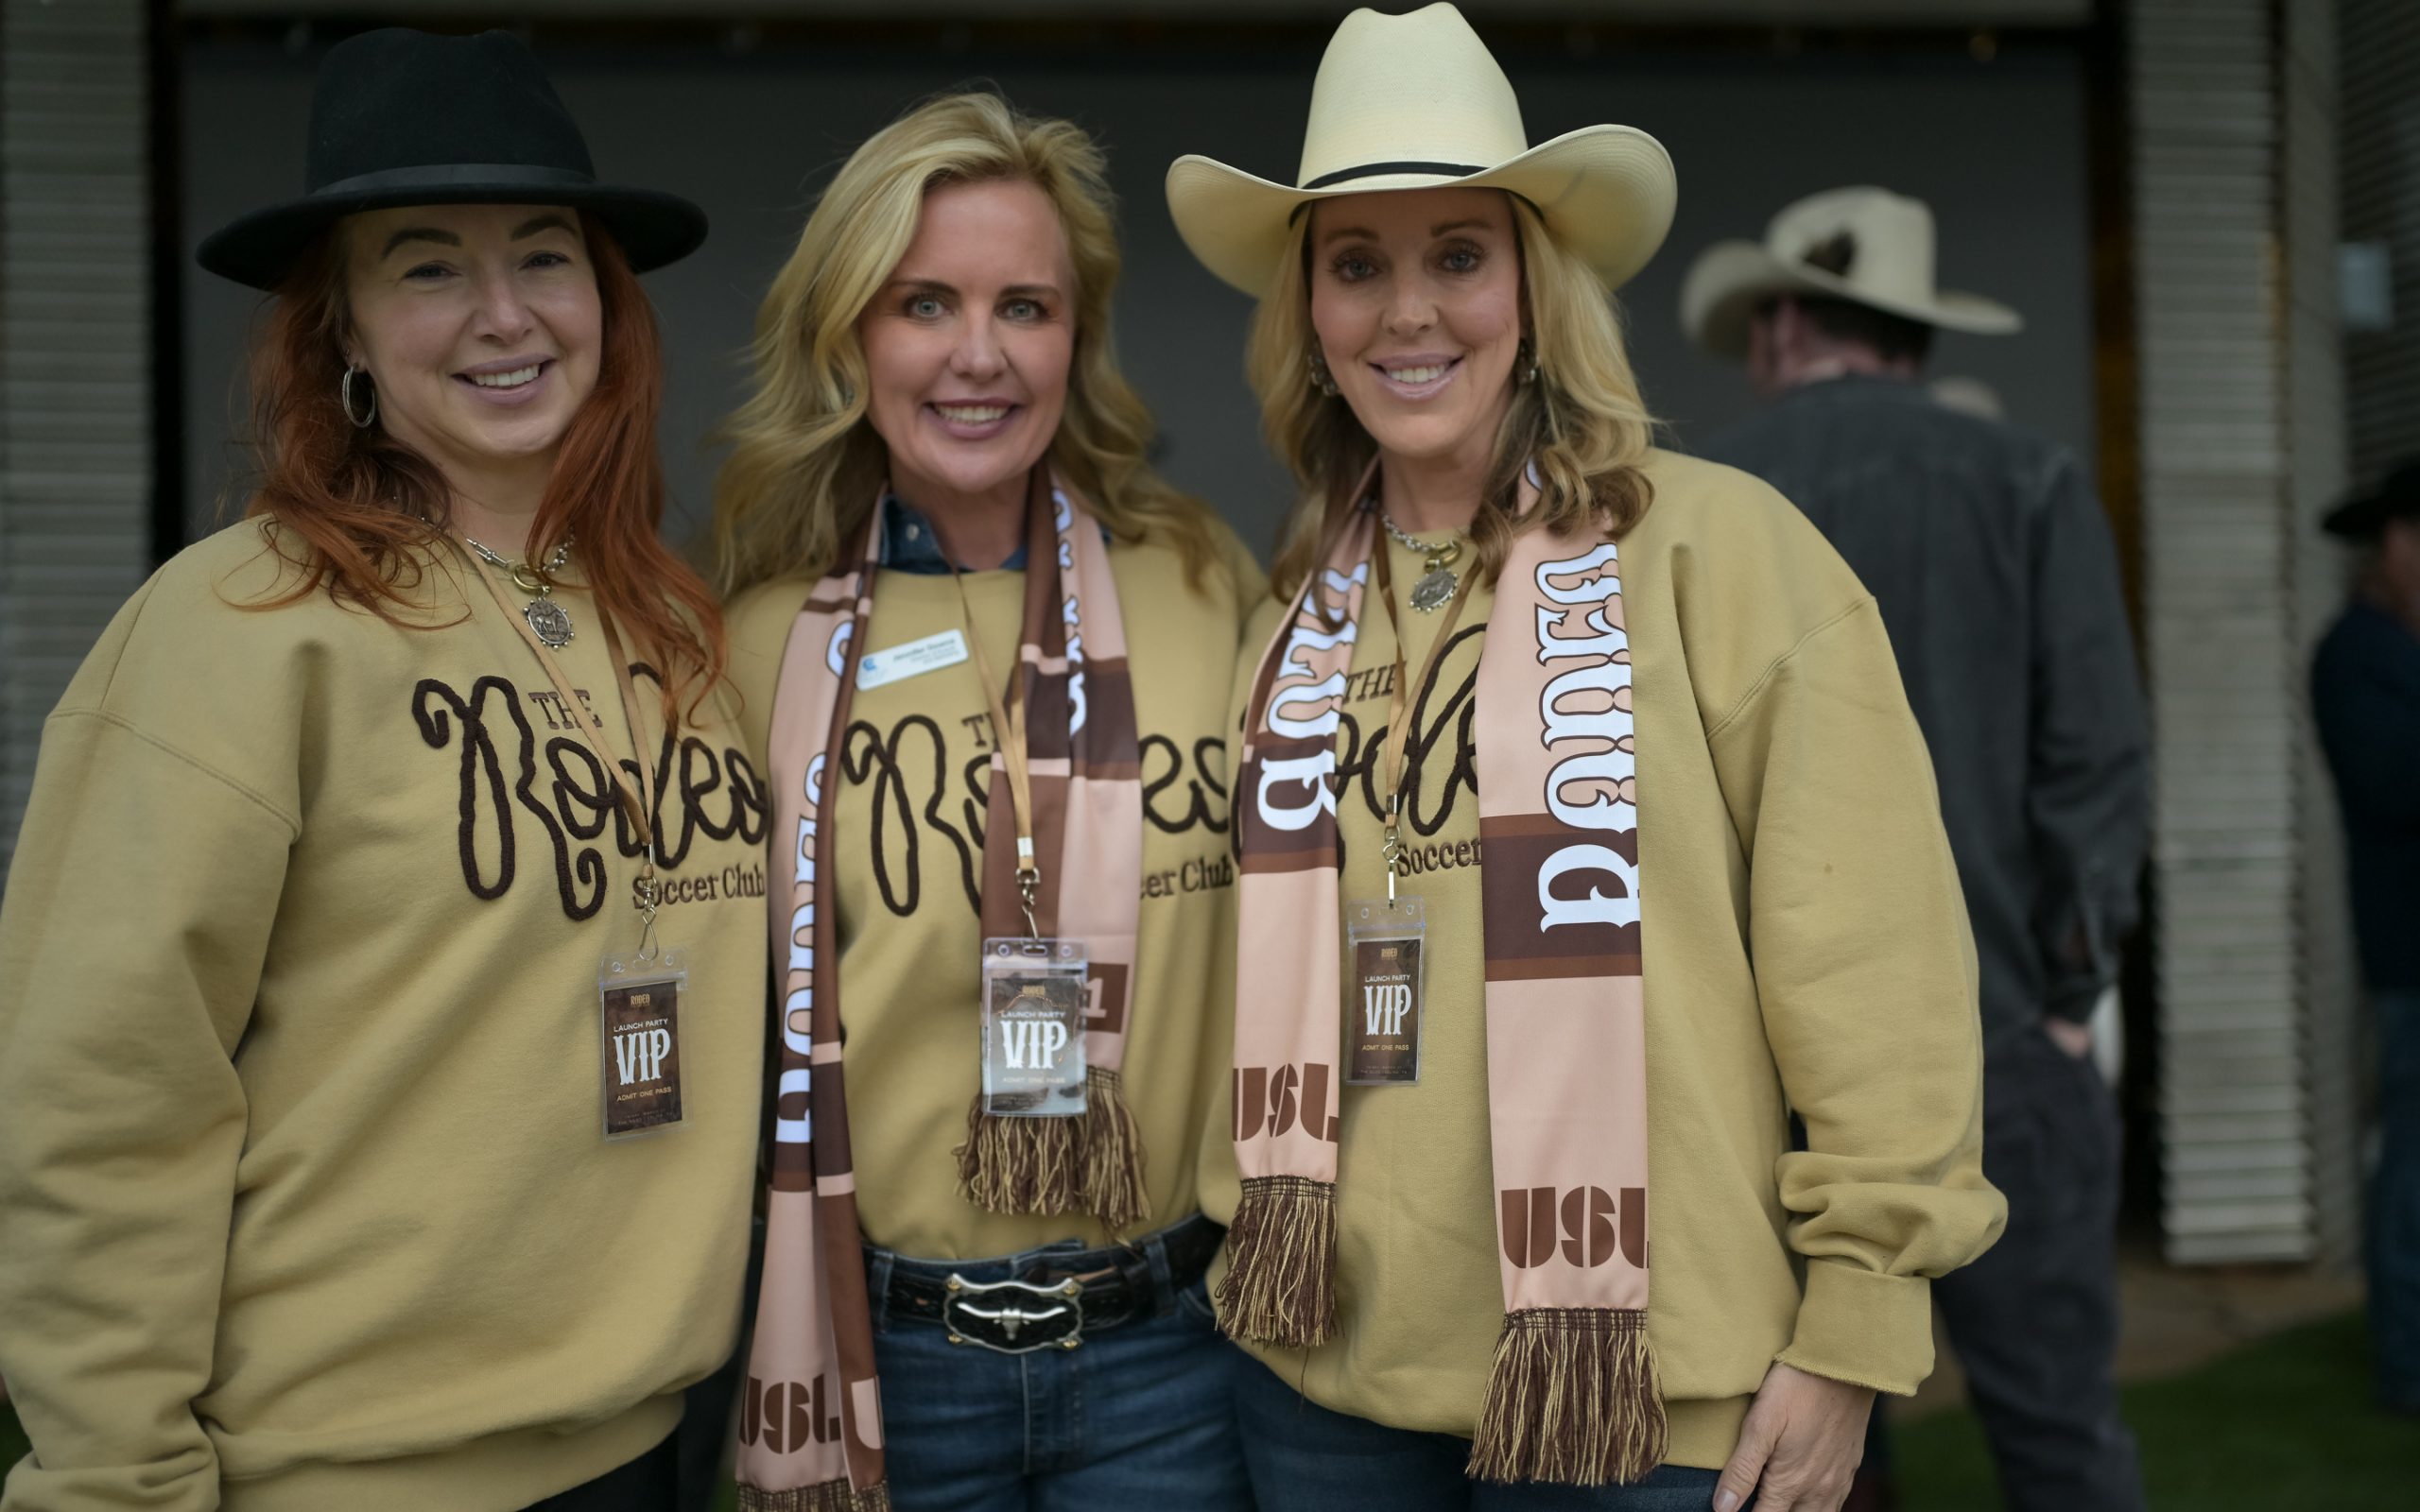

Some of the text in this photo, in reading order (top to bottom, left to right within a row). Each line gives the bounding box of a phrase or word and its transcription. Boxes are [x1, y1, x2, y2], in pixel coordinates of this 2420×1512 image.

[411, 662, 769, 922] Rodeo
[631, 863, 766, 910] Soccer Club
[1364, 973, 1411, 983] LAUNCH PARTY
[614, 1018, 669, 1033] LAUNCH PARTY
[1363, 984, 1412, 1037] VIP
[613, 1027, 672, 1087] VIP
[999, 1020, 1067, 1070] VIP
[616, 1092, 637, 1103] ADMIT
[655, 1086, 672, 1094] PASS
